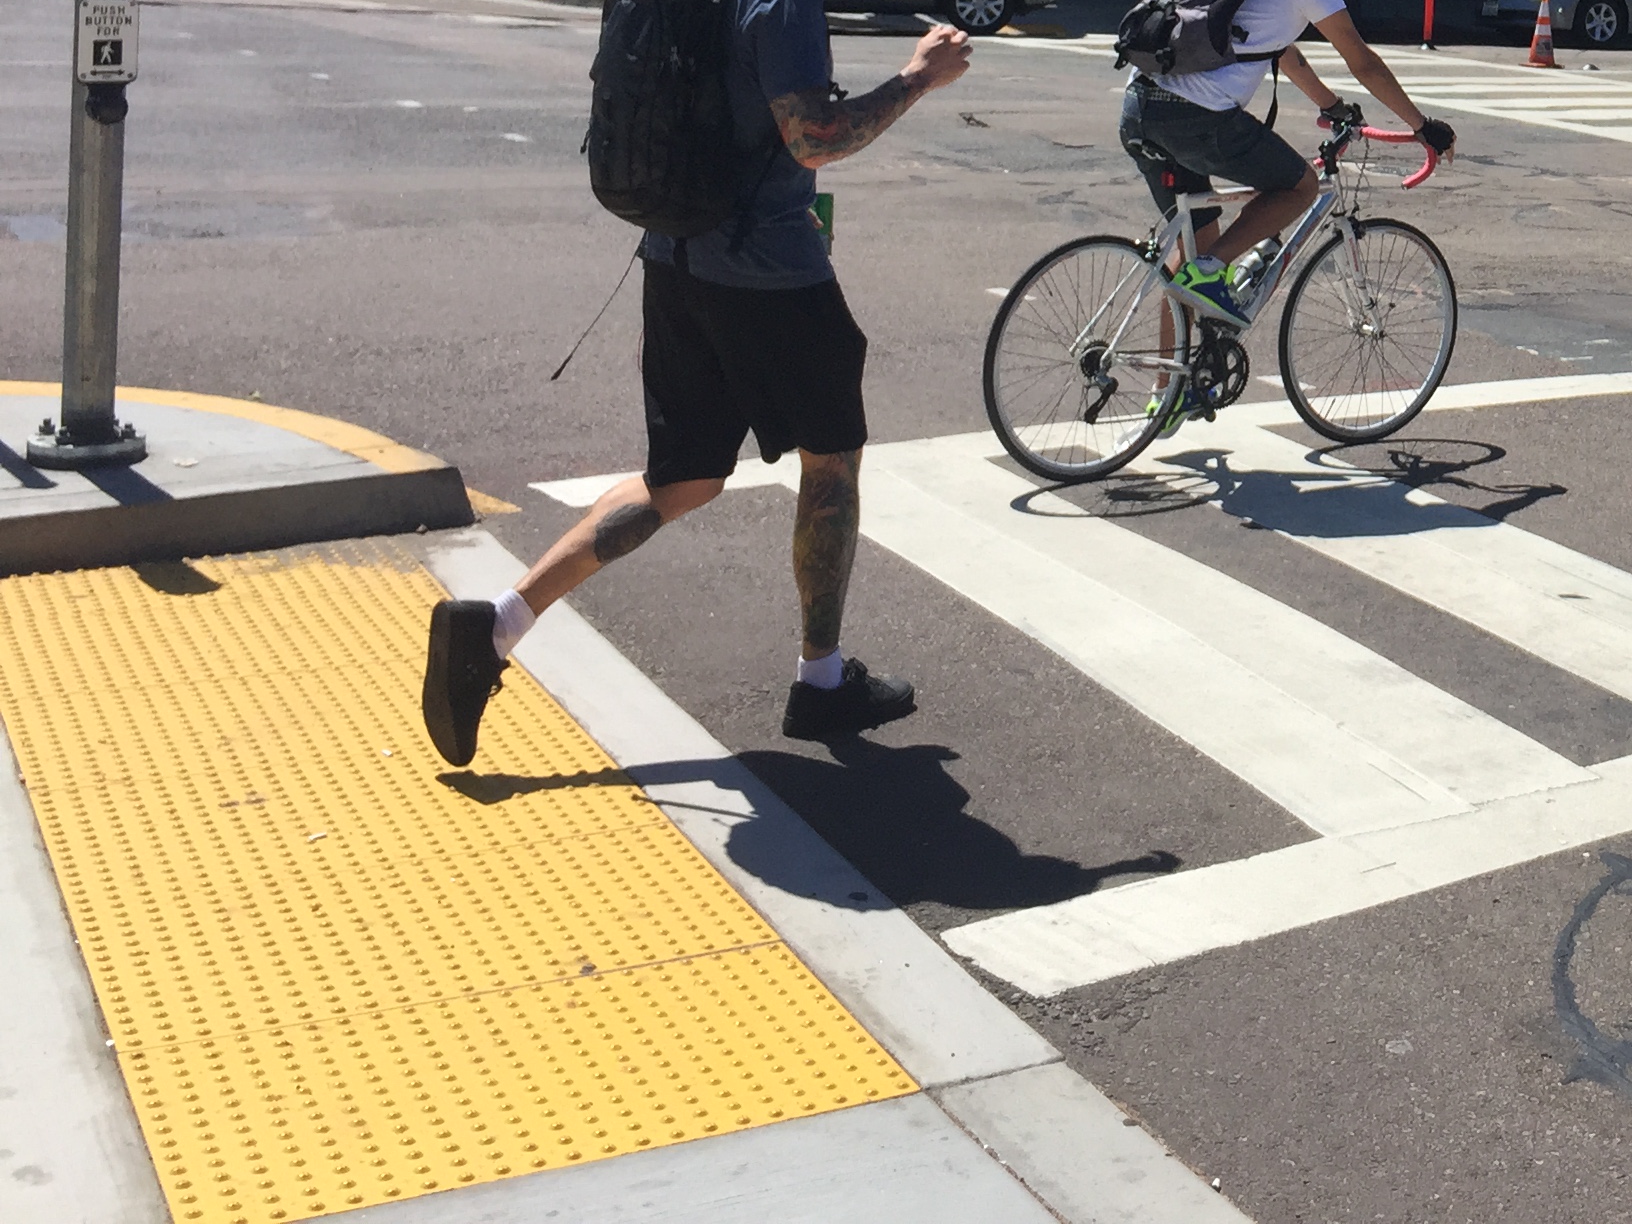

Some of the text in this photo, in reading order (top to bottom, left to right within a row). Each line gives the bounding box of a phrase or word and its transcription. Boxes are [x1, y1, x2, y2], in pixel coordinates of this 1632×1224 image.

[93, 5, 126, 15] PUSH
[85, 16, 132, 26] BUTTON
[97, 27, 120, 36] FOR
